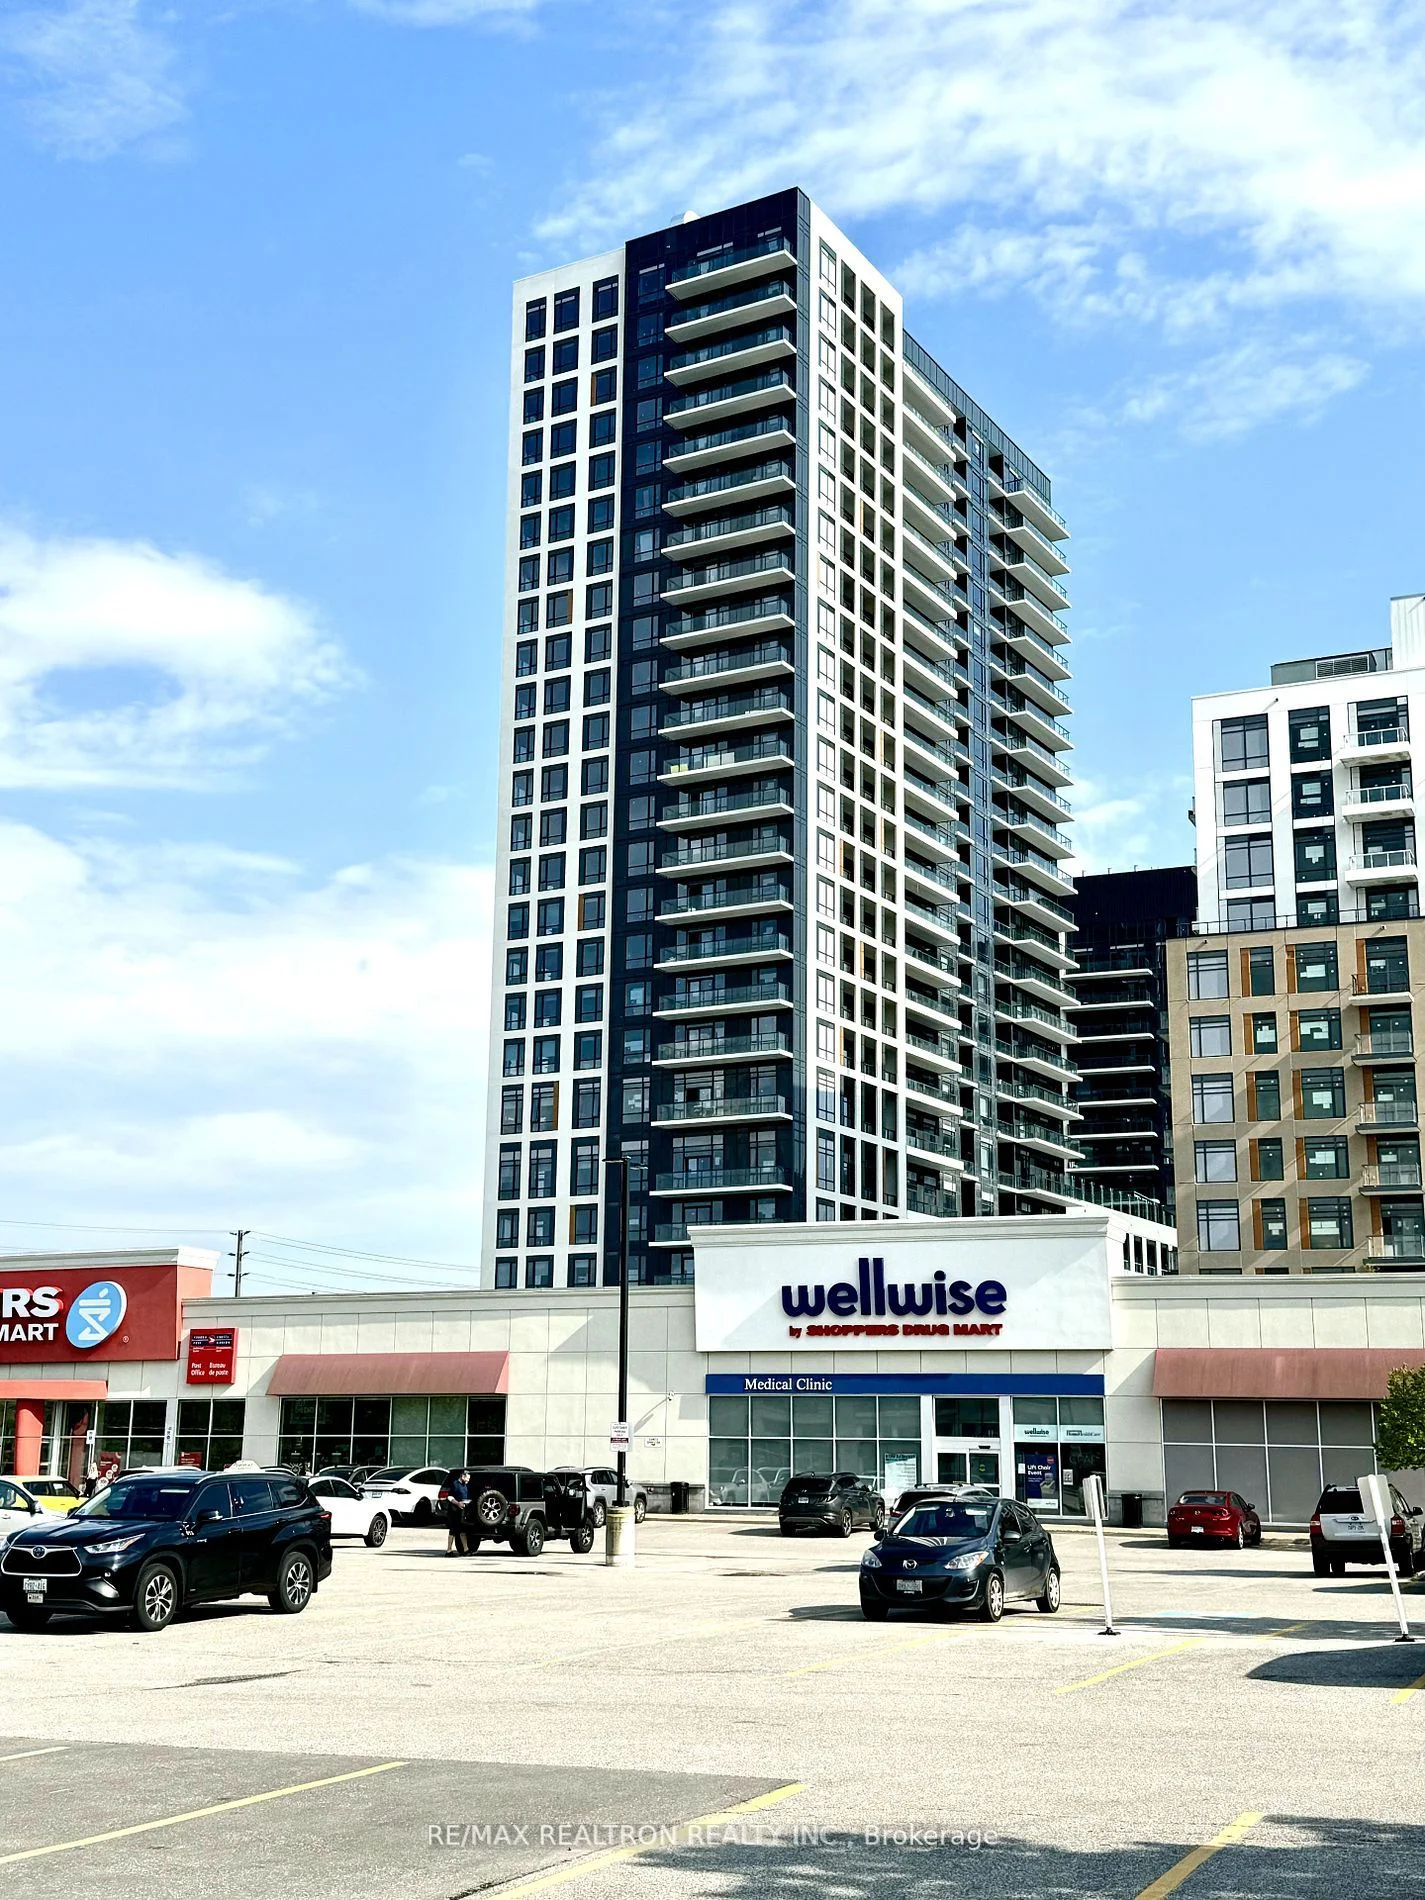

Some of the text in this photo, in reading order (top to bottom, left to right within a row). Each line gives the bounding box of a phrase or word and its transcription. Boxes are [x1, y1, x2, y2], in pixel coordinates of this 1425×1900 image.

[781, 1257, 1008, 1318] wellwise
[789, 1323, 1003, 1338] by SHOPPERS DRUG MART
[744, 1377, 833, 1391] Medical Clinic
